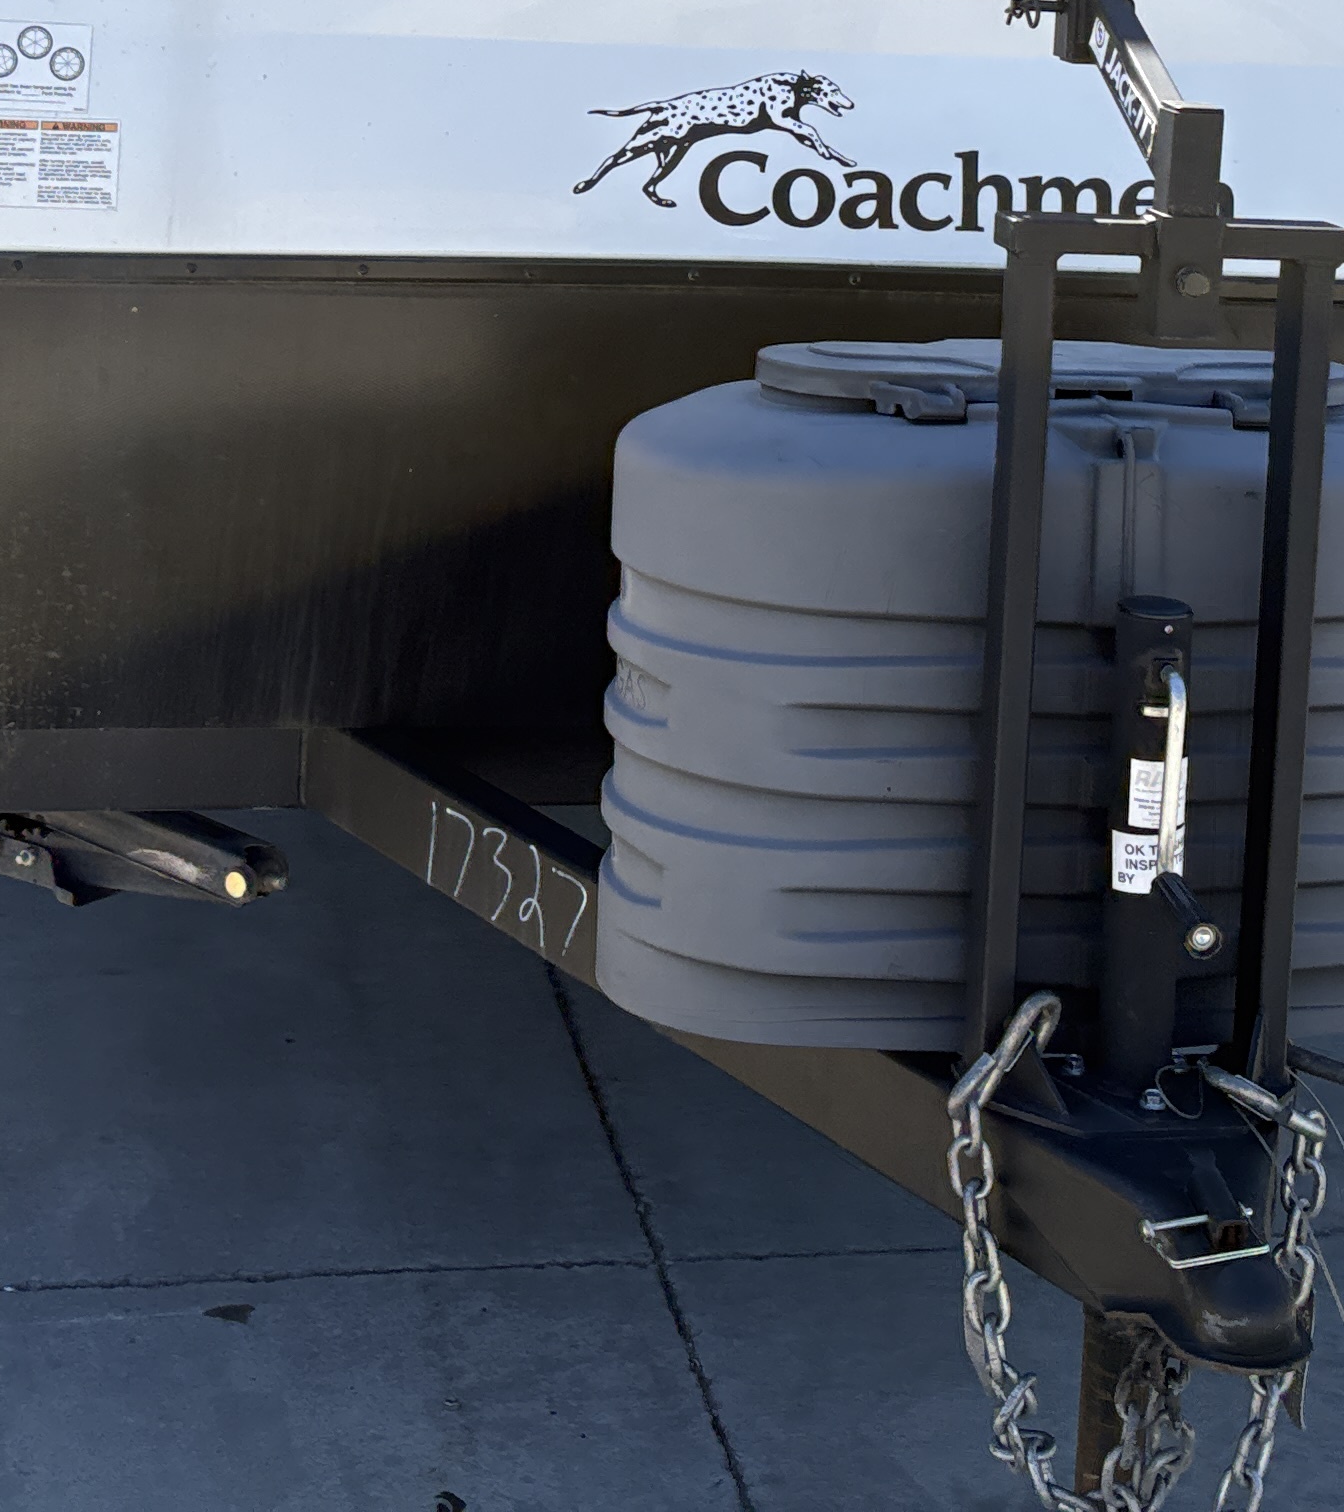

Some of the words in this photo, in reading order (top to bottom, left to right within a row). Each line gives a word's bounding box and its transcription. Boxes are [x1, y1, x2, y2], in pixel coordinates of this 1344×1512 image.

[1105, 47, 1154, 140] JACK-IT
[62, 121, 106, 131] WARNING
[1125, 843, 1145, 856] OK
[427, 801, 588, 957] 17327
[1118, 871, 1135, 884] BY
